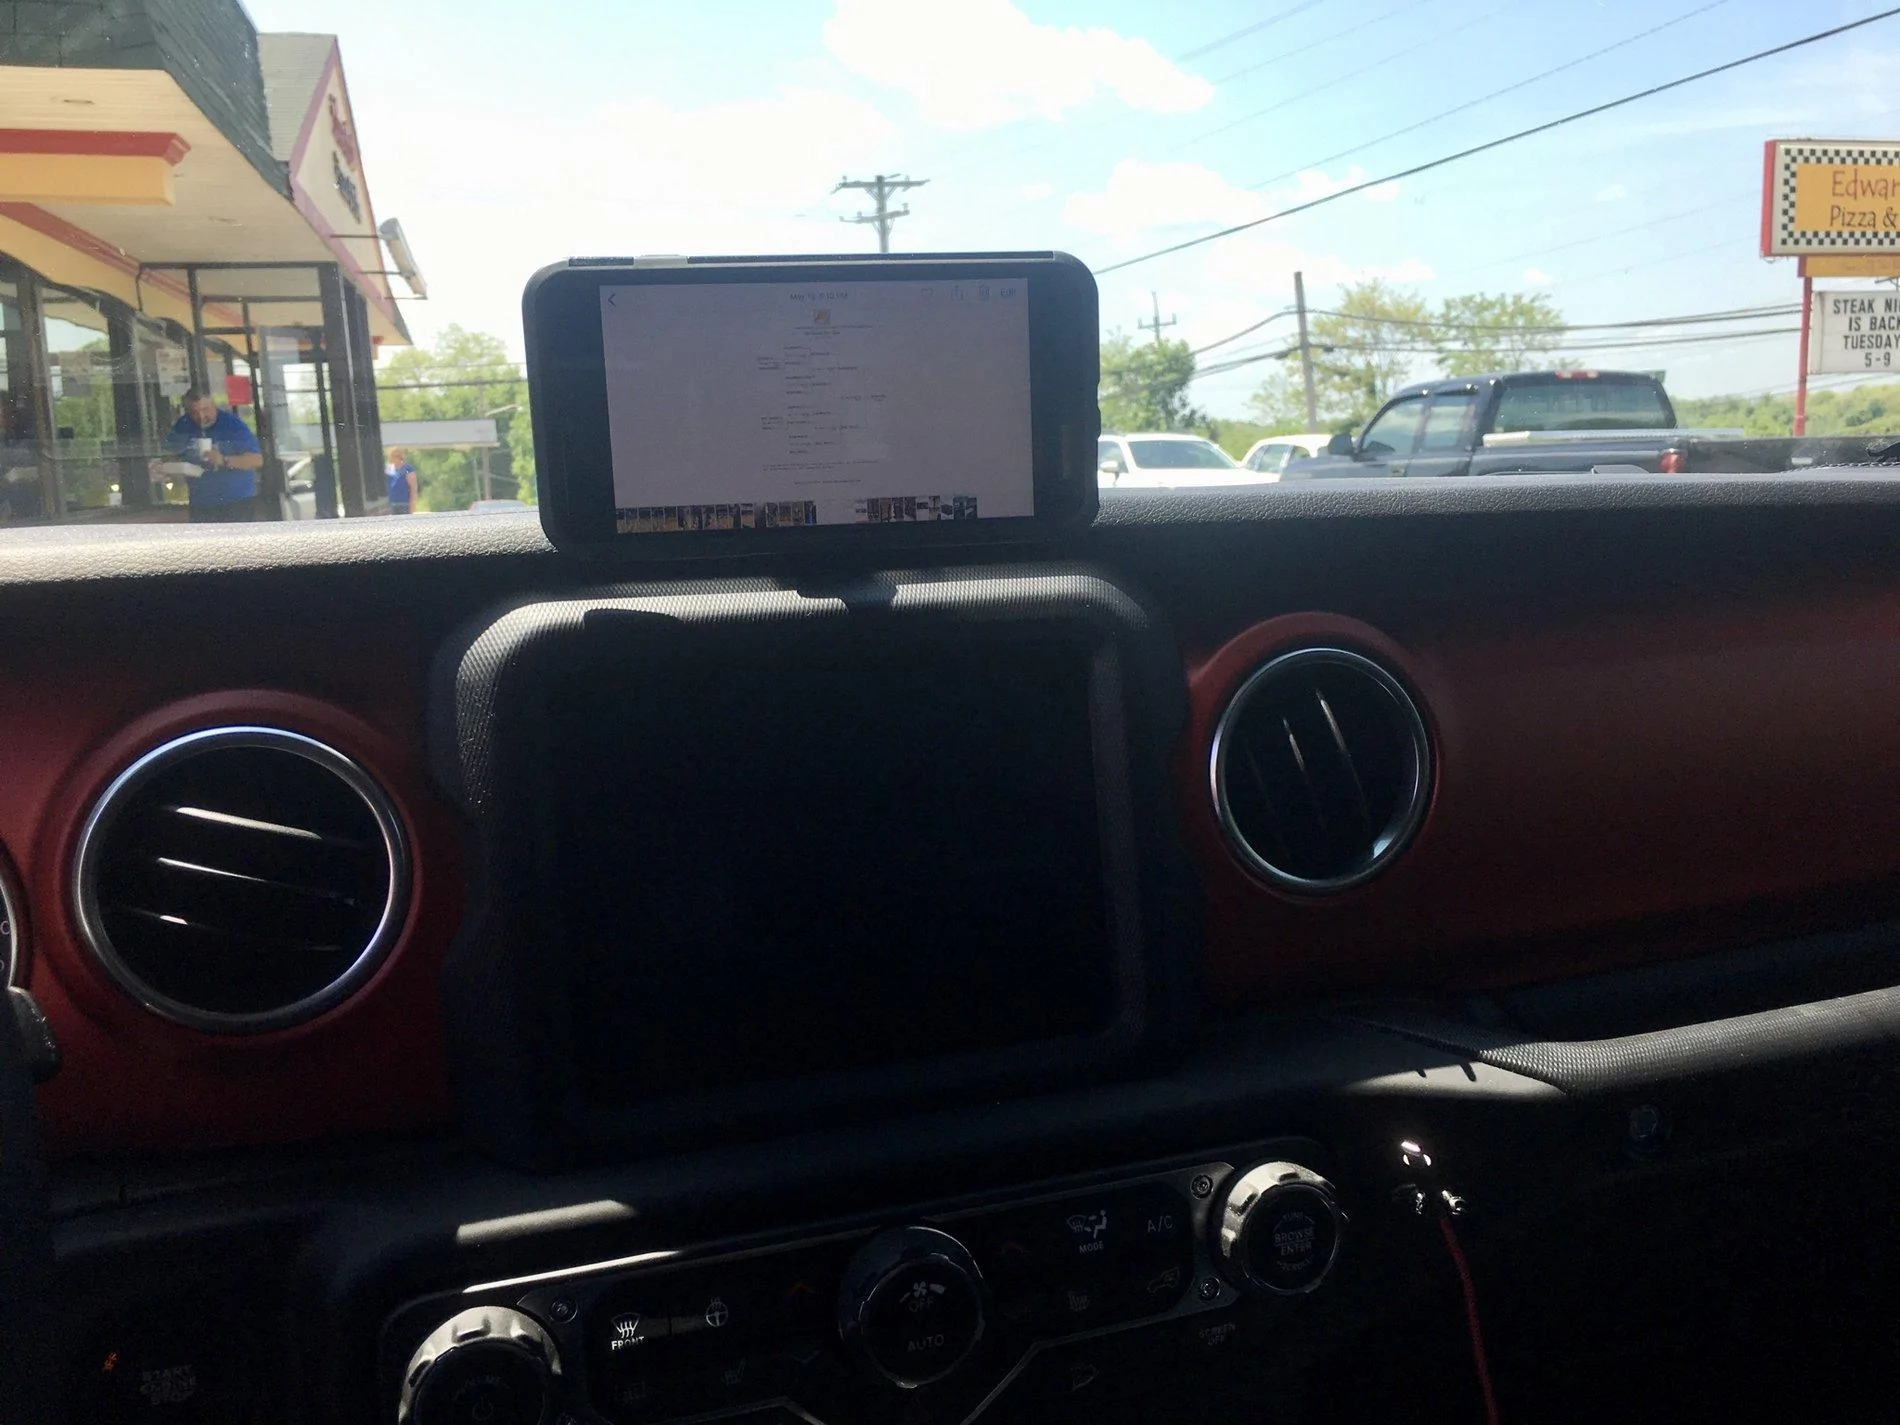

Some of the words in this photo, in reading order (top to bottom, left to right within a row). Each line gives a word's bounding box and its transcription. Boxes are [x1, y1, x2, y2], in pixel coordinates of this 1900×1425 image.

[1829, 204, 1876, 228] Pizza
[1883, 206, 1897, 229] &
[1833, 298, 1875, 315] STEAK
[1884, 298, 1900, 313] NI
[1848, 316, 1861, 332] IS
[1843, 334, 1900, 350] TUESDAY
[1147, 1214, 1174, 1233] A/C
[1078, 1239, 1105, 1256] MODE
[611, 1336, 645, 1351] FRONT
[907, 1333, 945, 1353] AUTO
